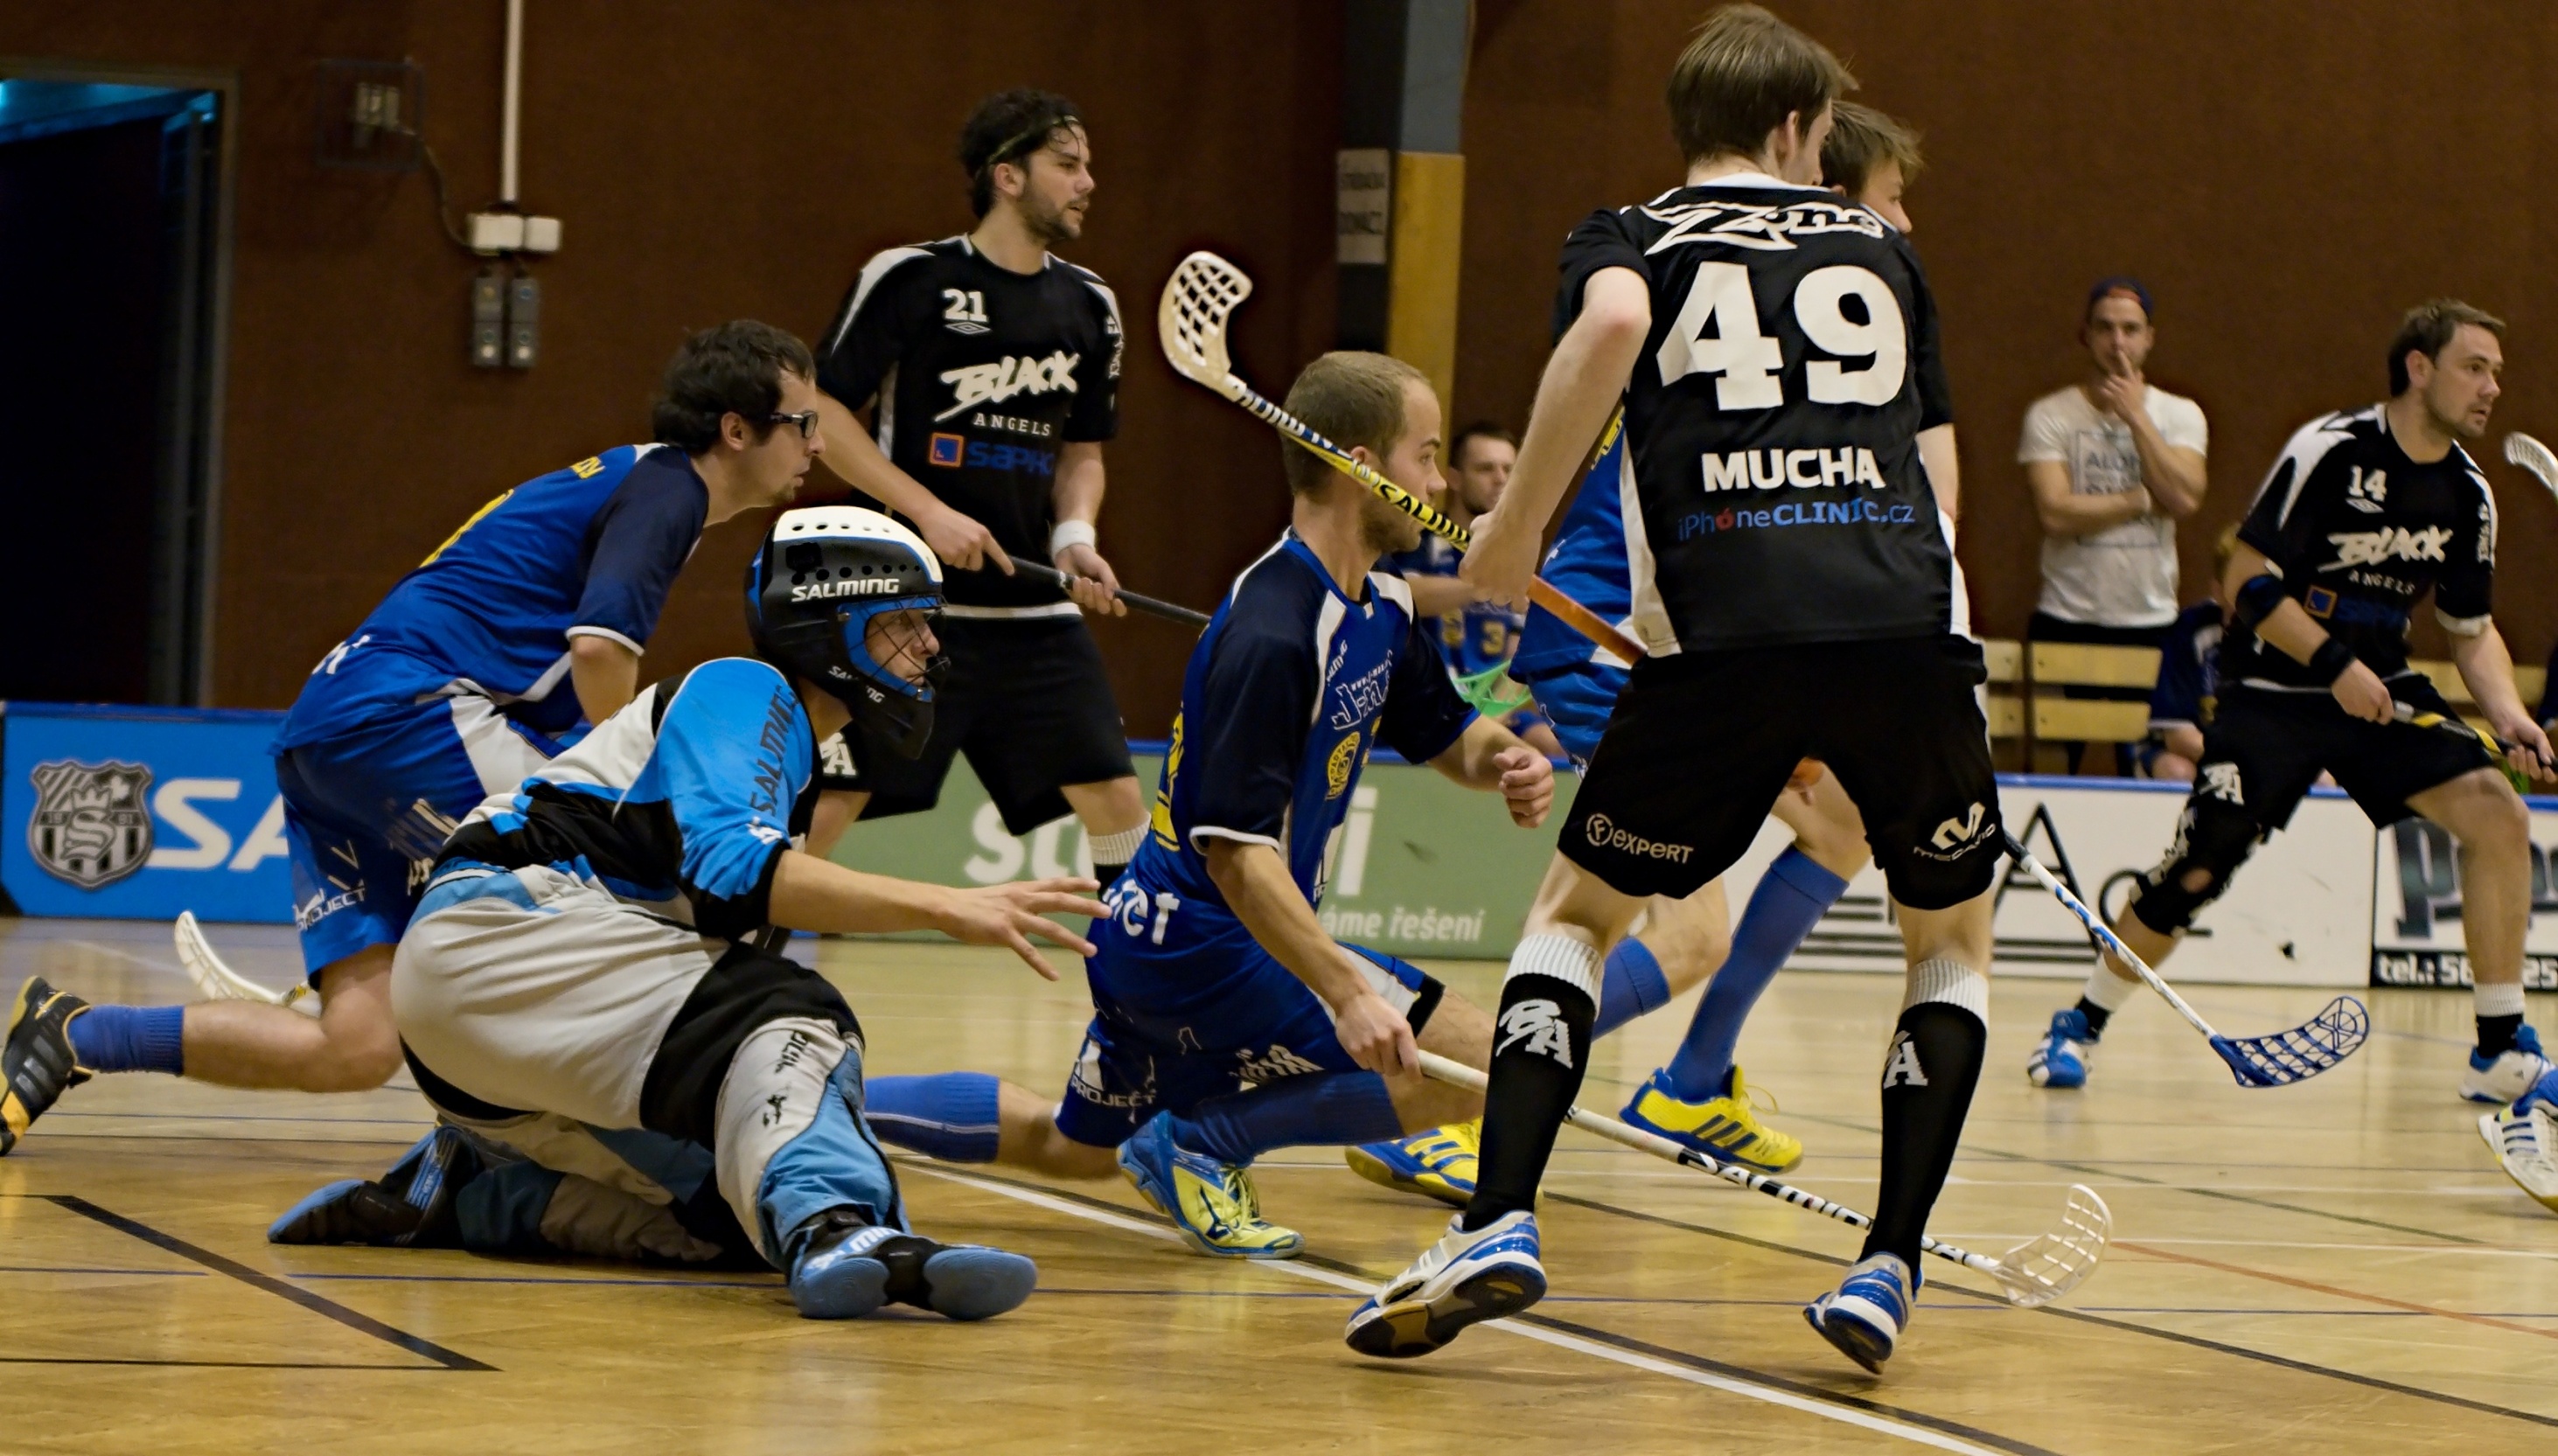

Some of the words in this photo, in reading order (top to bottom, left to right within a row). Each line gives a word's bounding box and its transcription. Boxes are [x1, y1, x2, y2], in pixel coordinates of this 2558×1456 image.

[941, 289, 988, 324] 21
[1656, 261, 1907, 411] 49
[934, 350, 1081, 422] BLACK
[973, 412, 1052, 437] ANGELS
[1701, 445, 1887, 492] MUCHA
[2347, 464, 2387, 502] 14
[2317, 524, 2454, 574] BLACK
[791, 578, 900, 603] SALMING
[2348, 568, 2415, 595] ANGELS
[1319, 904, 1383, 938] áme
[1070, 1075, 1158, 1109] PROJECT
